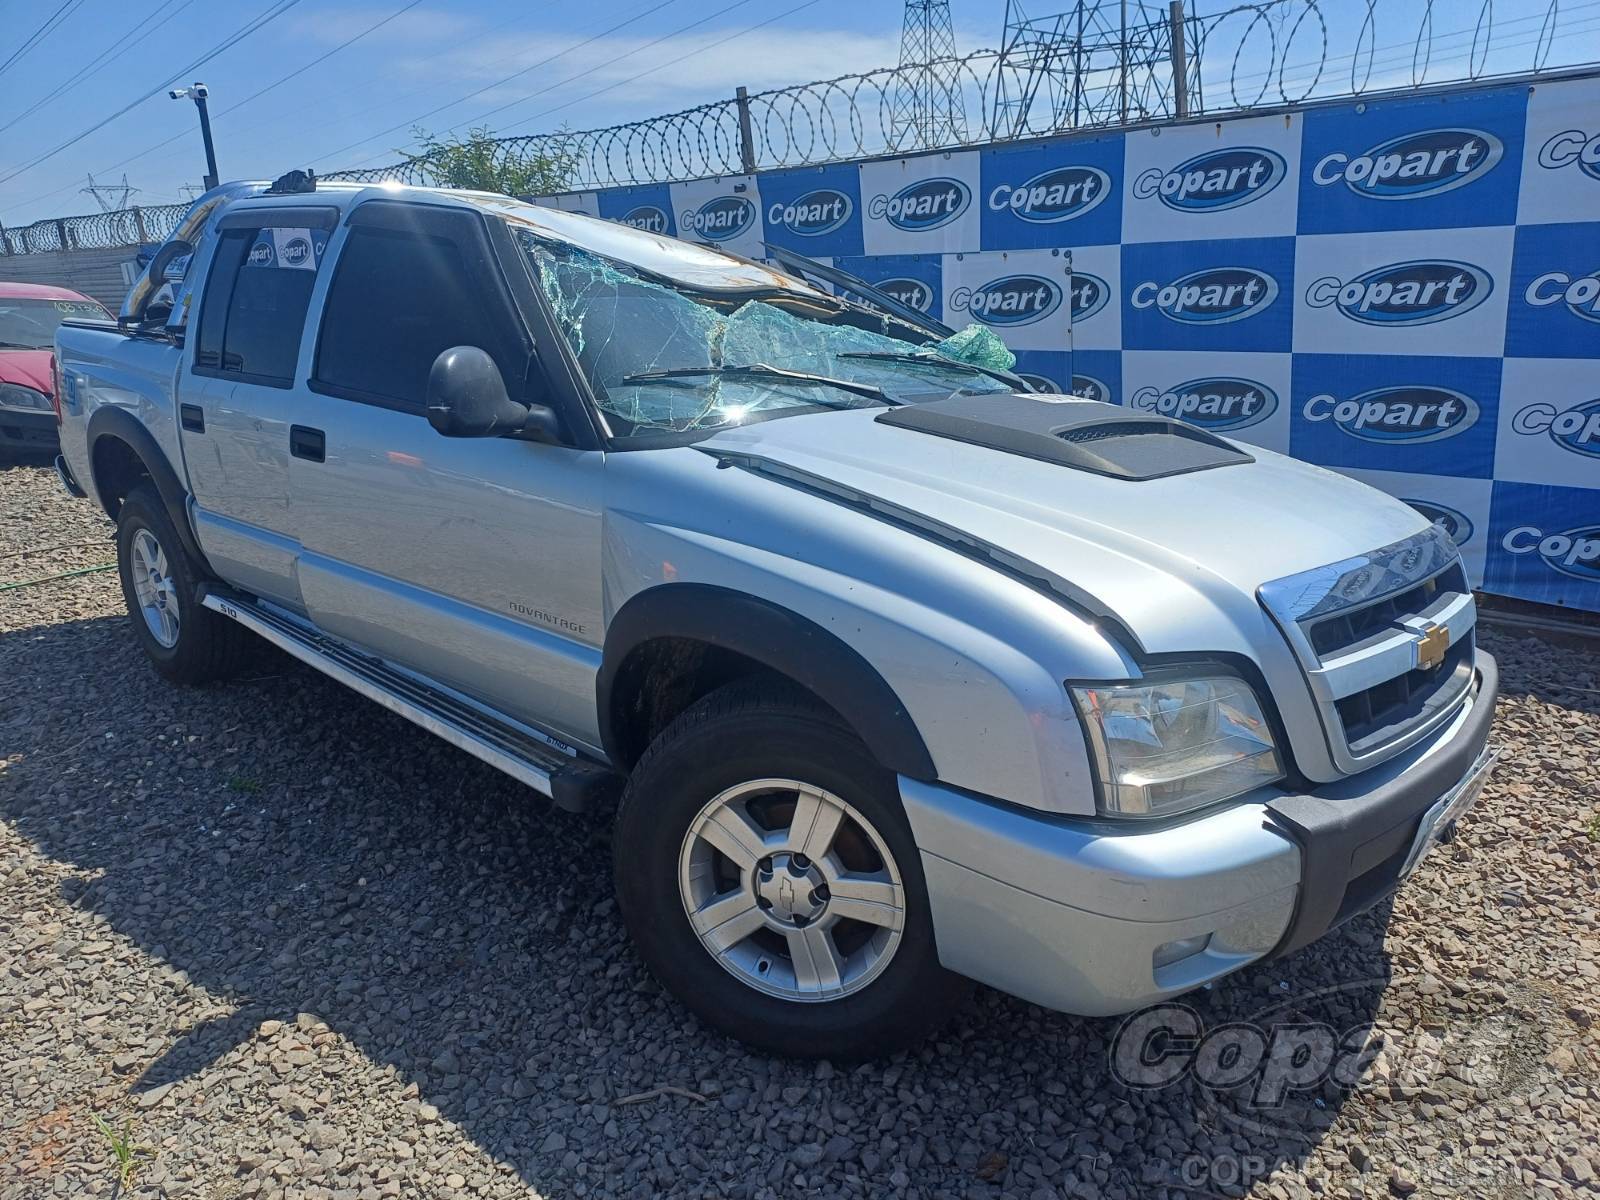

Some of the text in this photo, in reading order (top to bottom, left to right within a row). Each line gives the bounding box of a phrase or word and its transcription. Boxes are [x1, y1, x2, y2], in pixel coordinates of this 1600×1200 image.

[1313, 134, 1481, 188] Copart
[989, 176, 1097, 213] Copart
[1133, 157, 1267, 202] Copart
[680, 199, 747, 233] Copart
[768, 197, 843, 227] Copart
[869, 186, 957, 222] Copart
[279, 243, 307, 260] Copart
[950, 284, 1046, 316] Copart
[1131, 277, 1258, 313] Copart
[1305, 273, 1469, 313] Copart
[1131, 386, 1258, 418] Copart
[1302, 394, 1457, 430] Copart
[509, 601, 586, 634] ADVANTAGE
